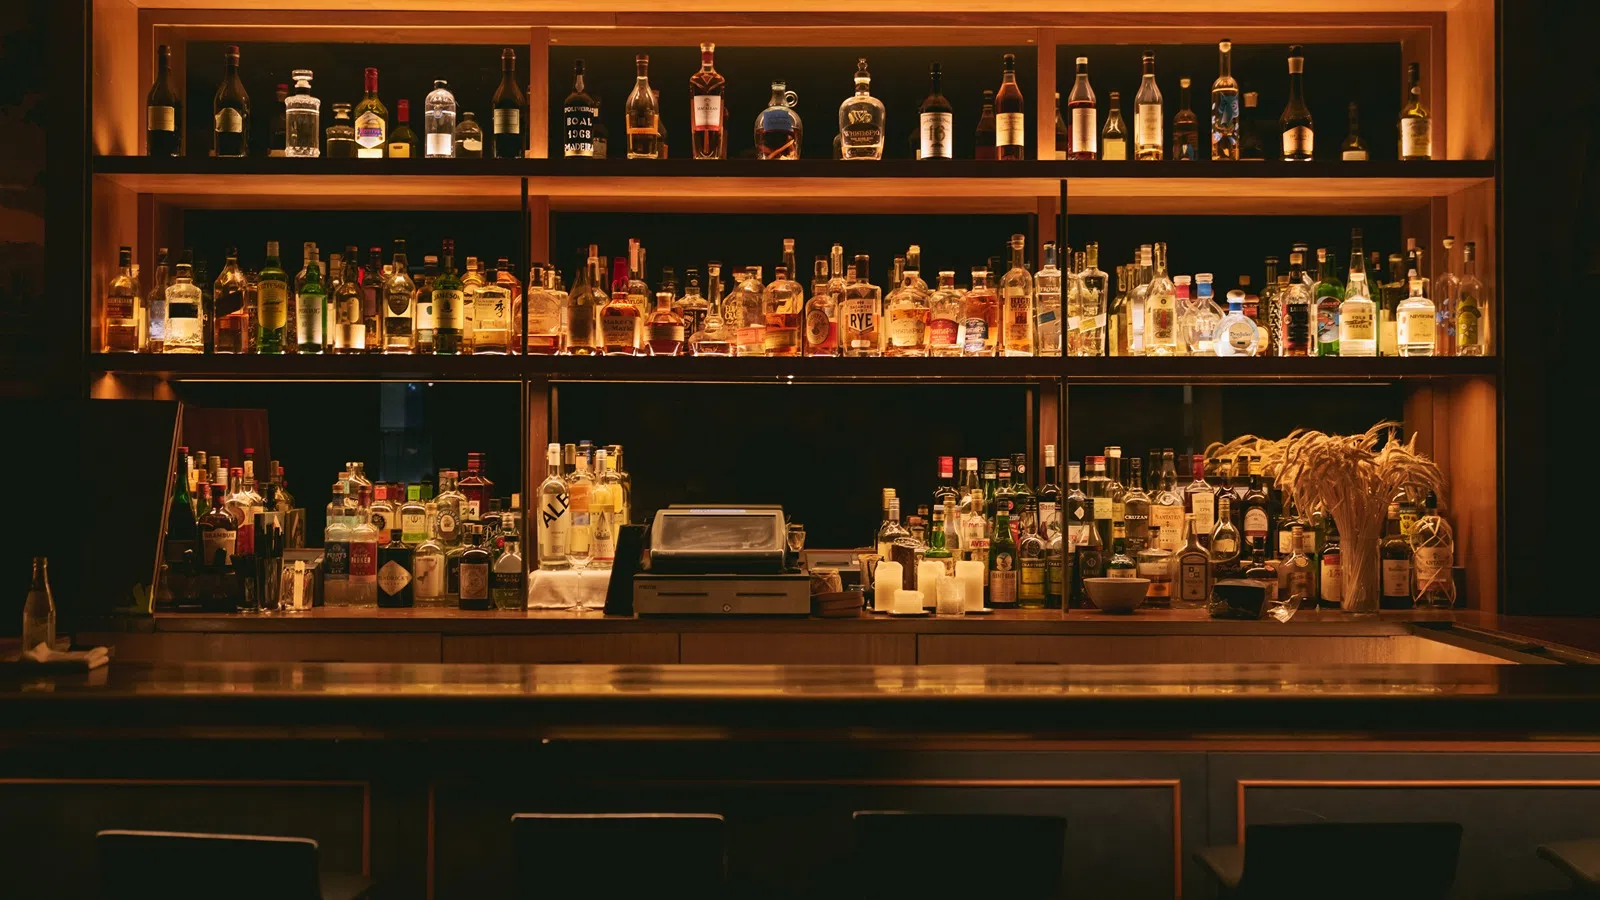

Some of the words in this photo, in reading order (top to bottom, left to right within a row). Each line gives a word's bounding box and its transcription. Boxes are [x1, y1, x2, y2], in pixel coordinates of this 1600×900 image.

[566, 117, 592, 126] BOAL
[567, 129, 591, 139] 1968
[929, 124, 945, 141] 16
[564, 143, 594, 152] MADEIRA
[434, 292, 461, 301] JAMESON
[850, 313, 873, 330] RYE
